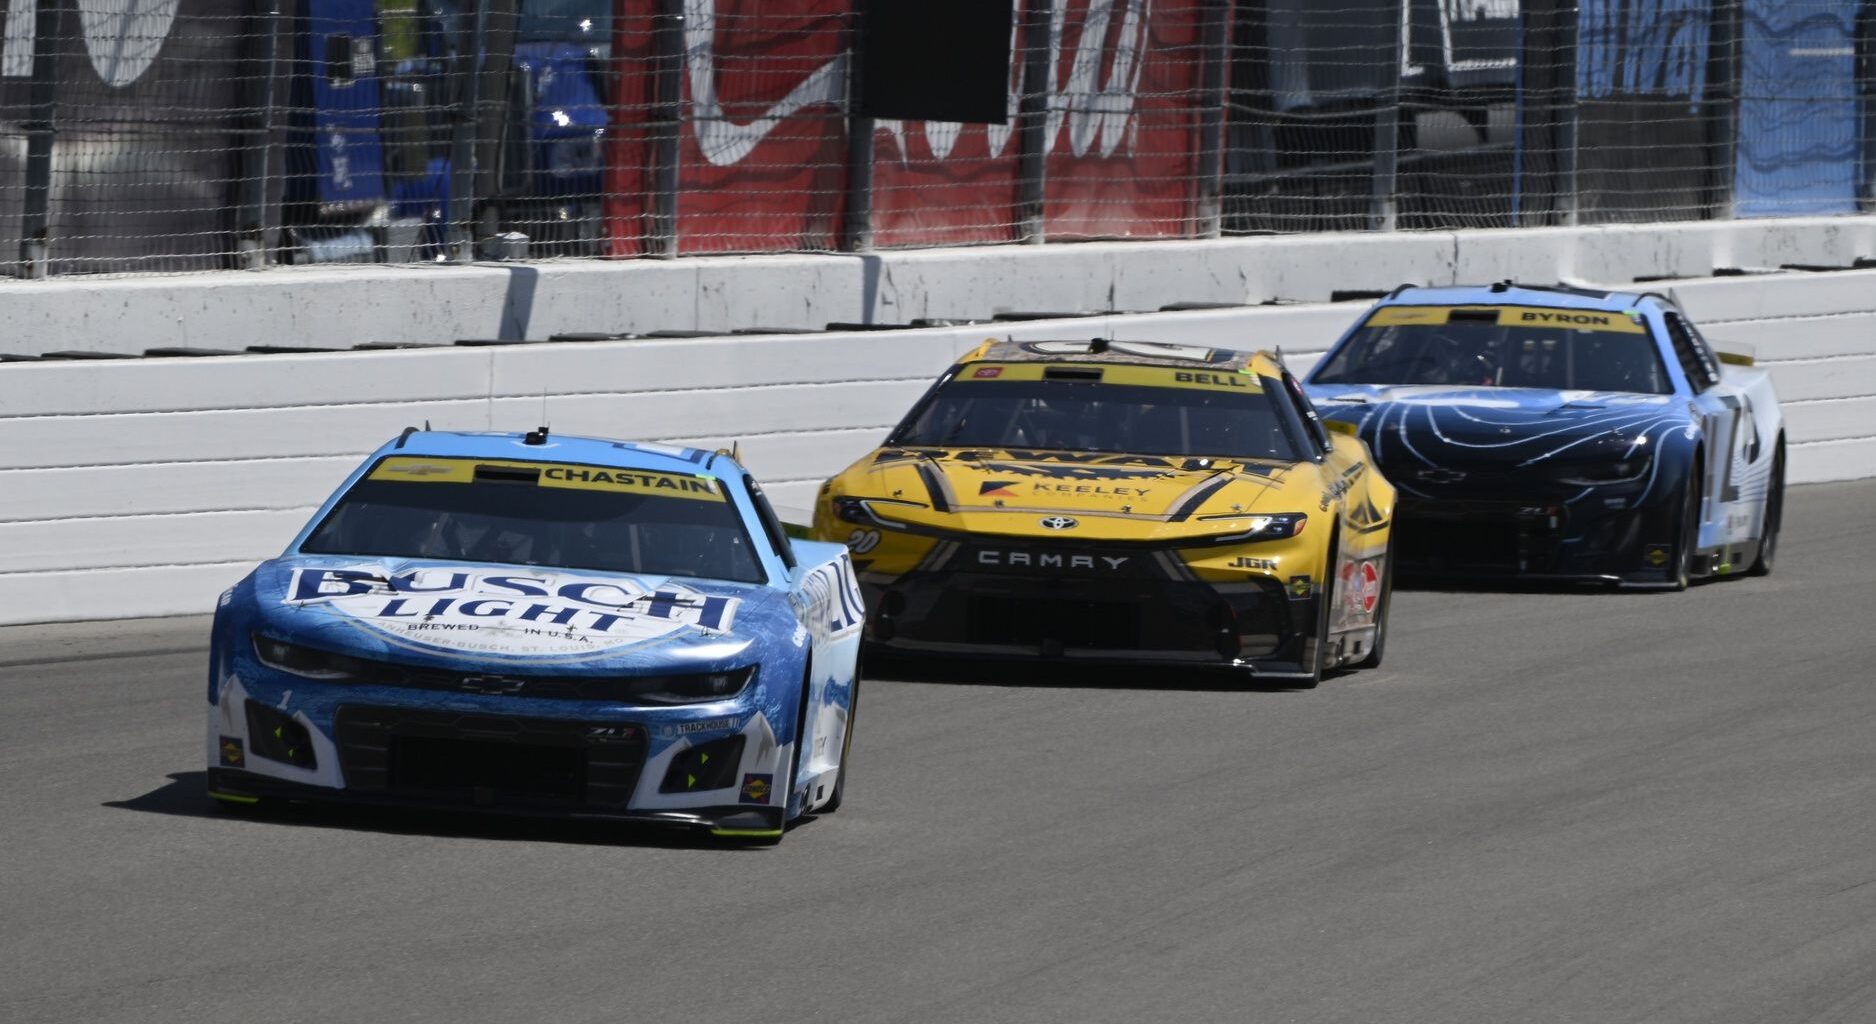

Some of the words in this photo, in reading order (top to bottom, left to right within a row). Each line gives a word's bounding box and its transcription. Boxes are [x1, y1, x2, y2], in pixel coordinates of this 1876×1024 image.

[1522, 312, 1609, 325] BYRON
[1175, 371, 1247, 387] BELL
[545, 468, 714, 494] CHASTAIN
[1033, 483, 1150, 496] KEELEY
[847, 529, 880, 553] 20
[978, 551, 1129, 570] CAMRY
[1228, 556, 1278, 571] JGR
[293, 568, 730, 631] BUSCH
[378, 598, 635, 632] LIGHT
[408, 623, 480, 631] BREWED
[276, 689, 293, 711] 1
